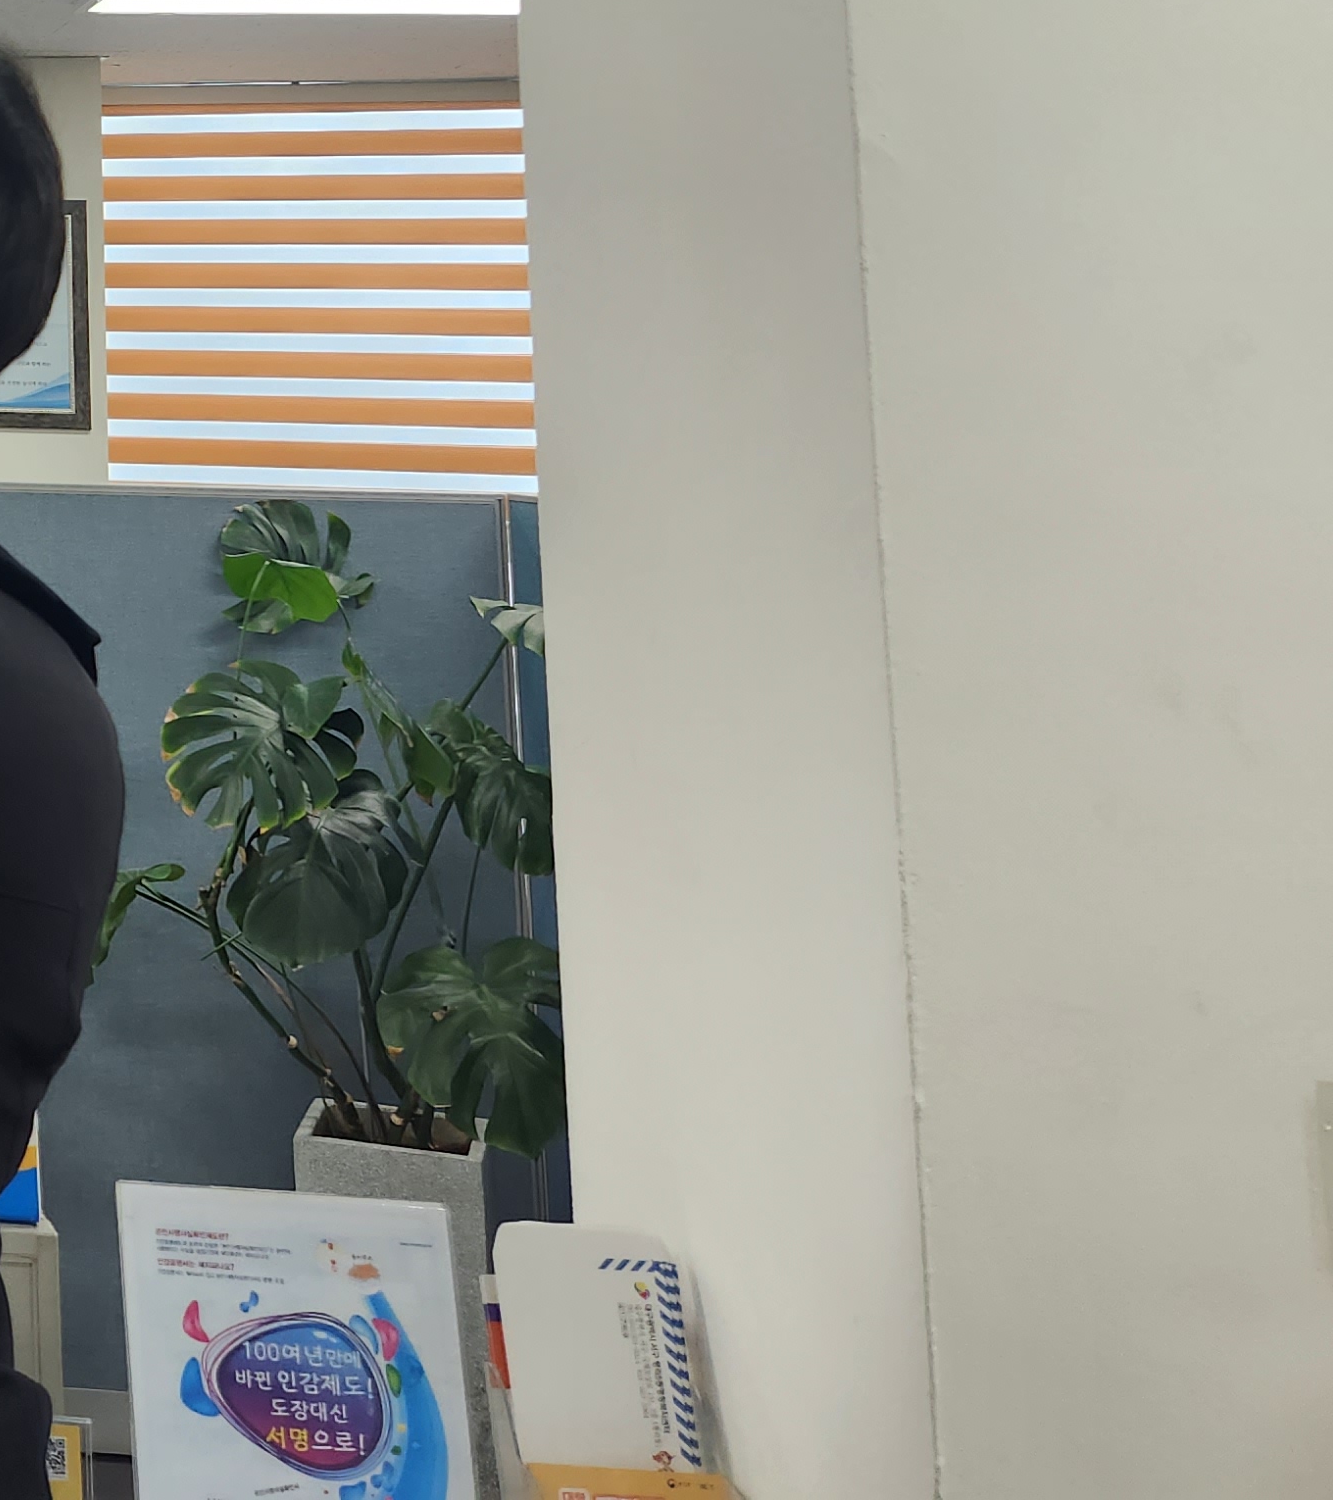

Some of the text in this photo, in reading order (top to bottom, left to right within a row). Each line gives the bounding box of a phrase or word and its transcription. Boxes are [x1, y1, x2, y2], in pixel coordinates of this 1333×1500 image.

[235, 1369, 374, 1399] 바뀐 인감제도!
[270, 1398, 349, 1424] 도장대신
[266, 1426, 366, 1456] 서명으로!
